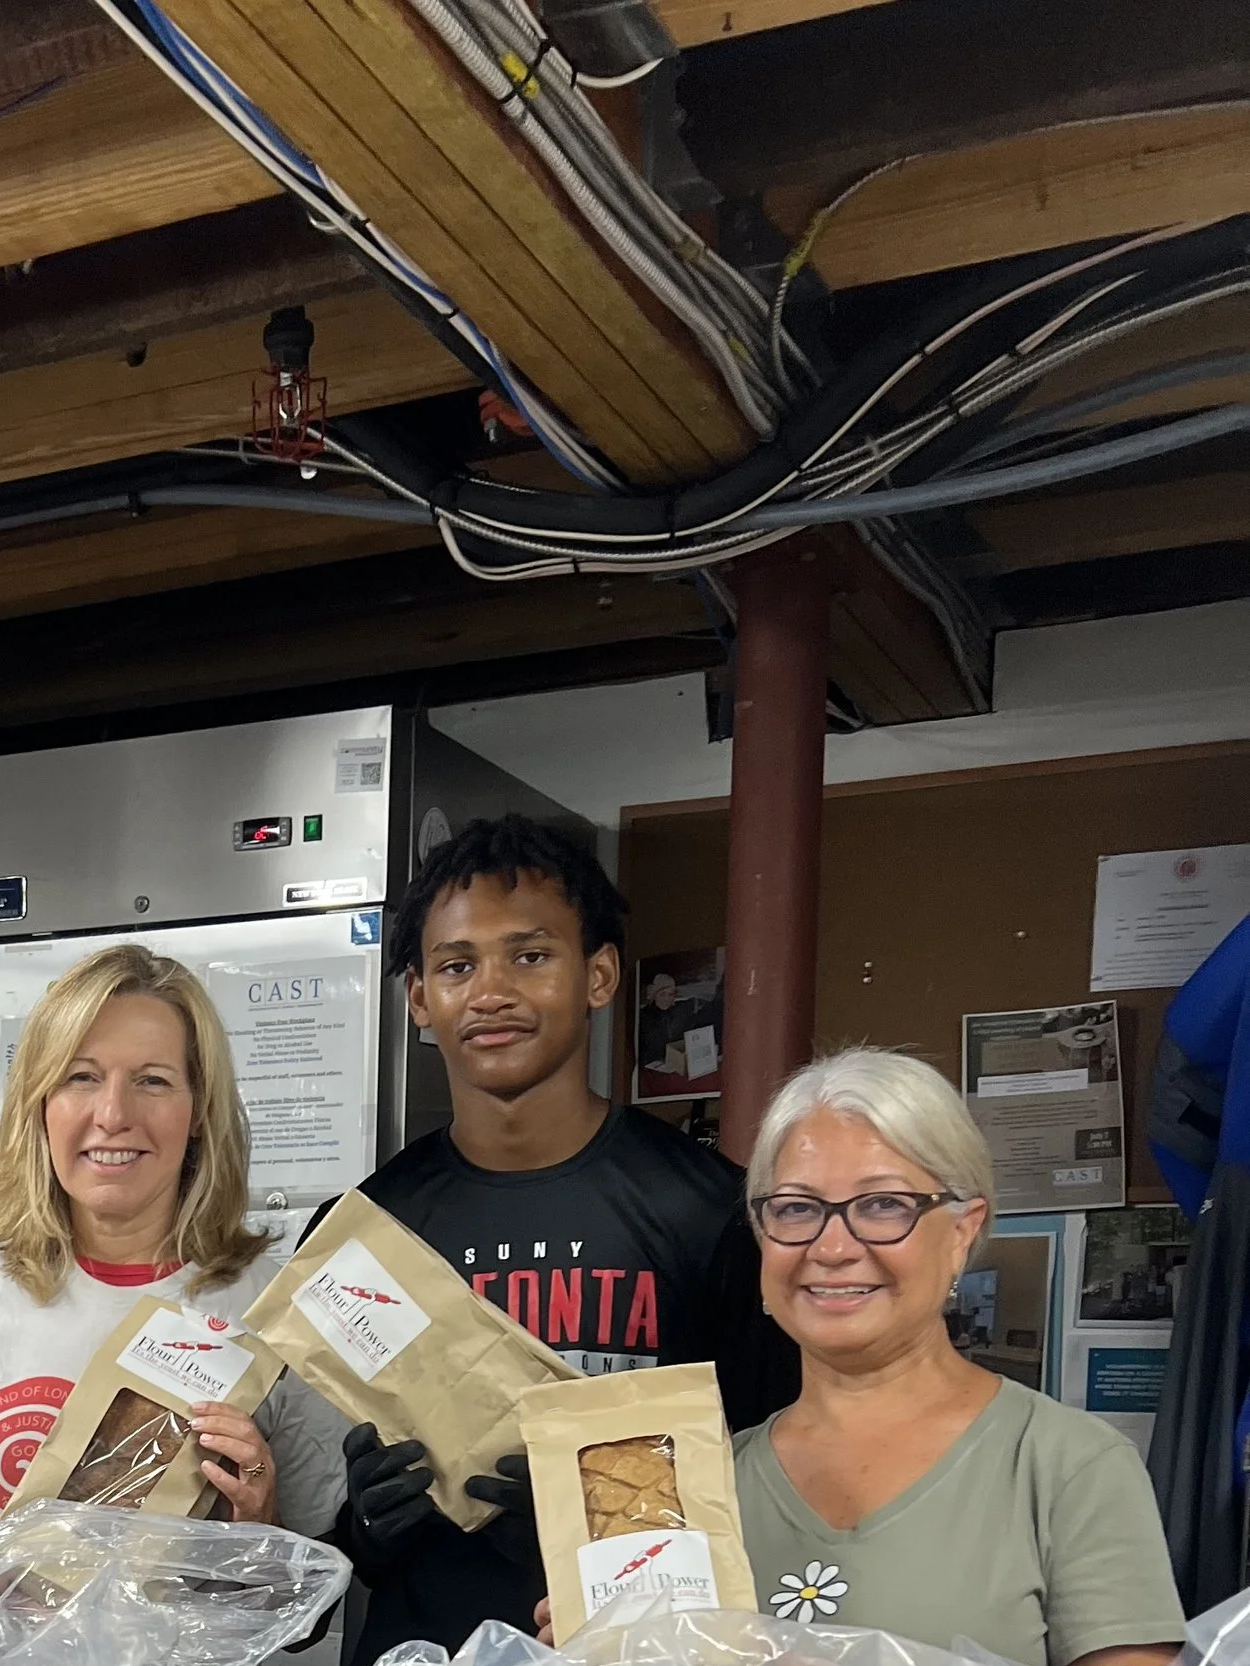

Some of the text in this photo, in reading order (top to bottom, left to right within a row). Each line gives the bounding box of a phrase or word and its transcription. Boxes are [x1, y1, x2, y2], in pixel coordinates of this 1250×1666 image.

[248, 978, 324, 1004] CAST
[464, 1240, 584, 1264] SUNY
[318, 1272, 392, 1356] Flour Power
[356, 1338, 370, 1352] can
[369, 1350, 380, 1364] do
[138, 1336, 228, 1391] Flour Power
[22, 1385, 42, 1398] OF
[192, 1380, 208, 1392] can
[208, 1386, 219, 1398] do
[1, 1422, 12, 1432] &
[656, 1573, 710, 1590] Power
